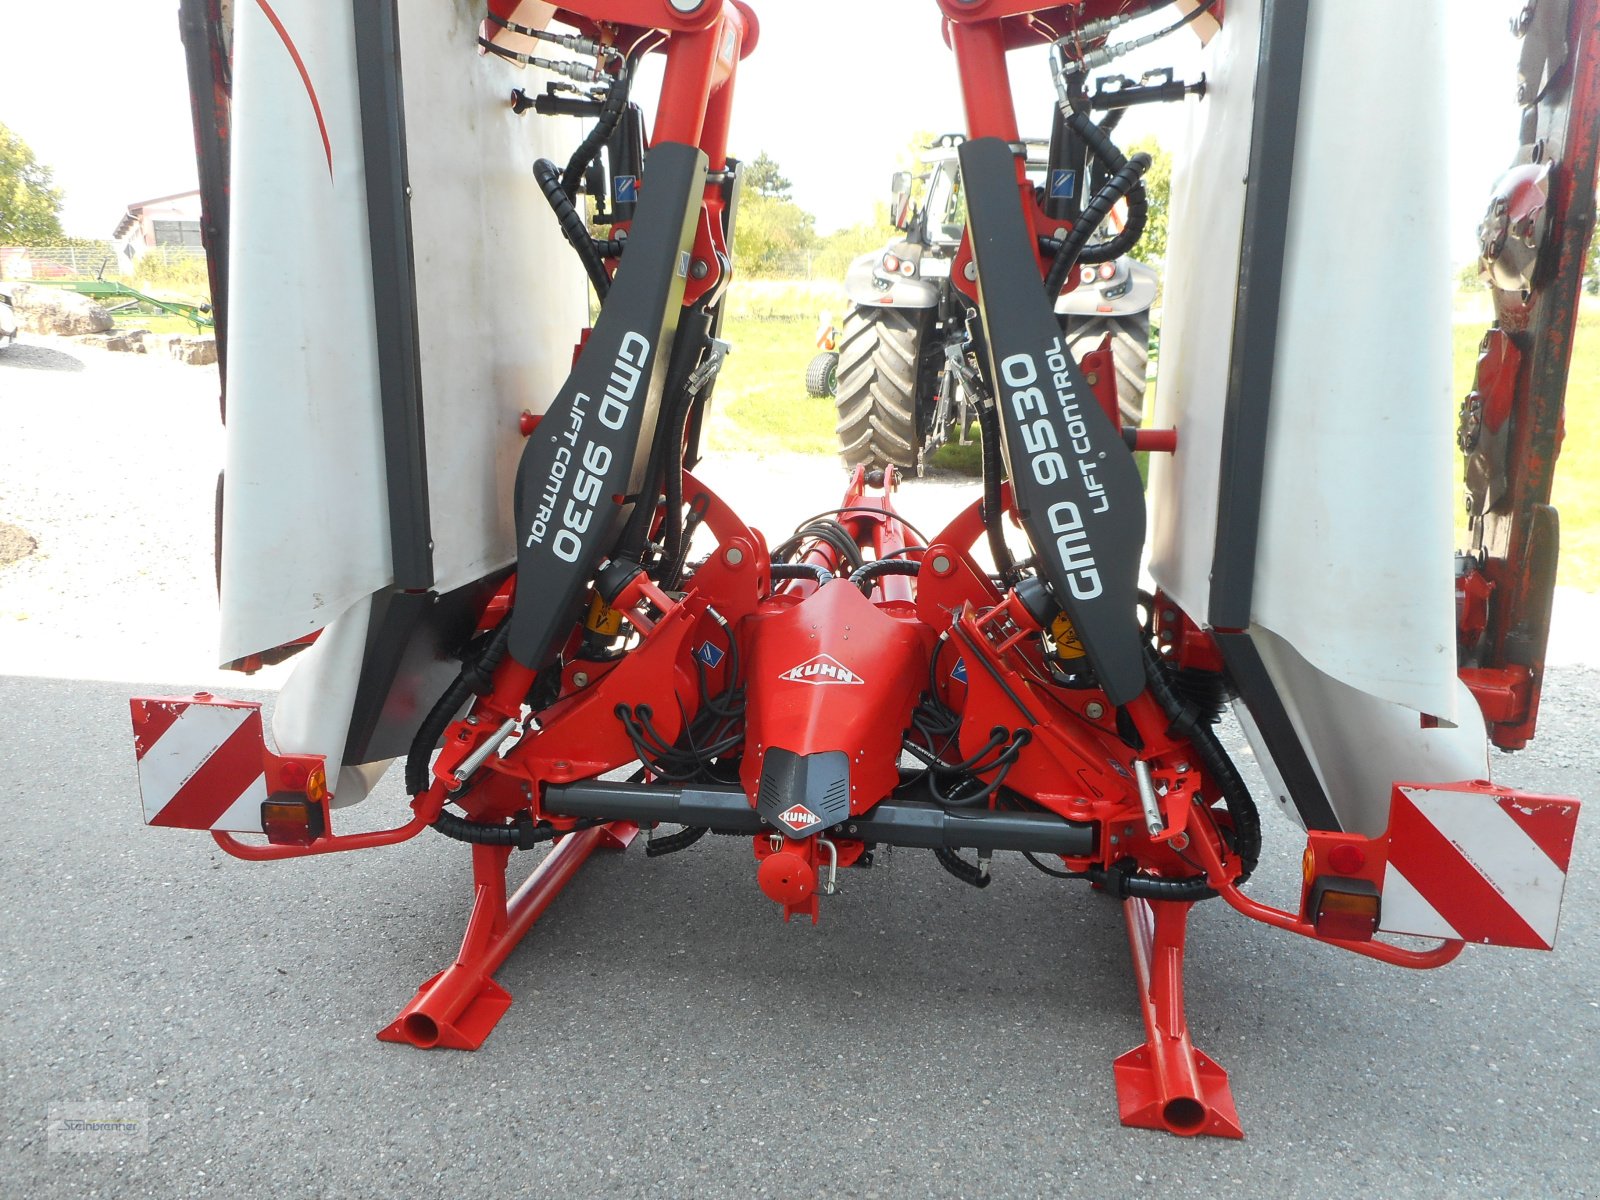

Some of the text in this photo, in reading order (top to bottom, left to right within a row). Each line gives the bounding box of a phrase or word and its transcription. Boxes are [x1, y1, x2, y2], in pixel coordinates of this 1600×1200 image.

[526, 392, 590, 548] LIFT CONTROL
[552, 331, 650, 563] GMD 9530
[1001, 353, 1103, 600] GMD 9530
[1045, 337, 1109, 514] LIFT CONTROL
[789, 663, 855, 683] KUHN
[783, 811, 817, 824] KUHN
